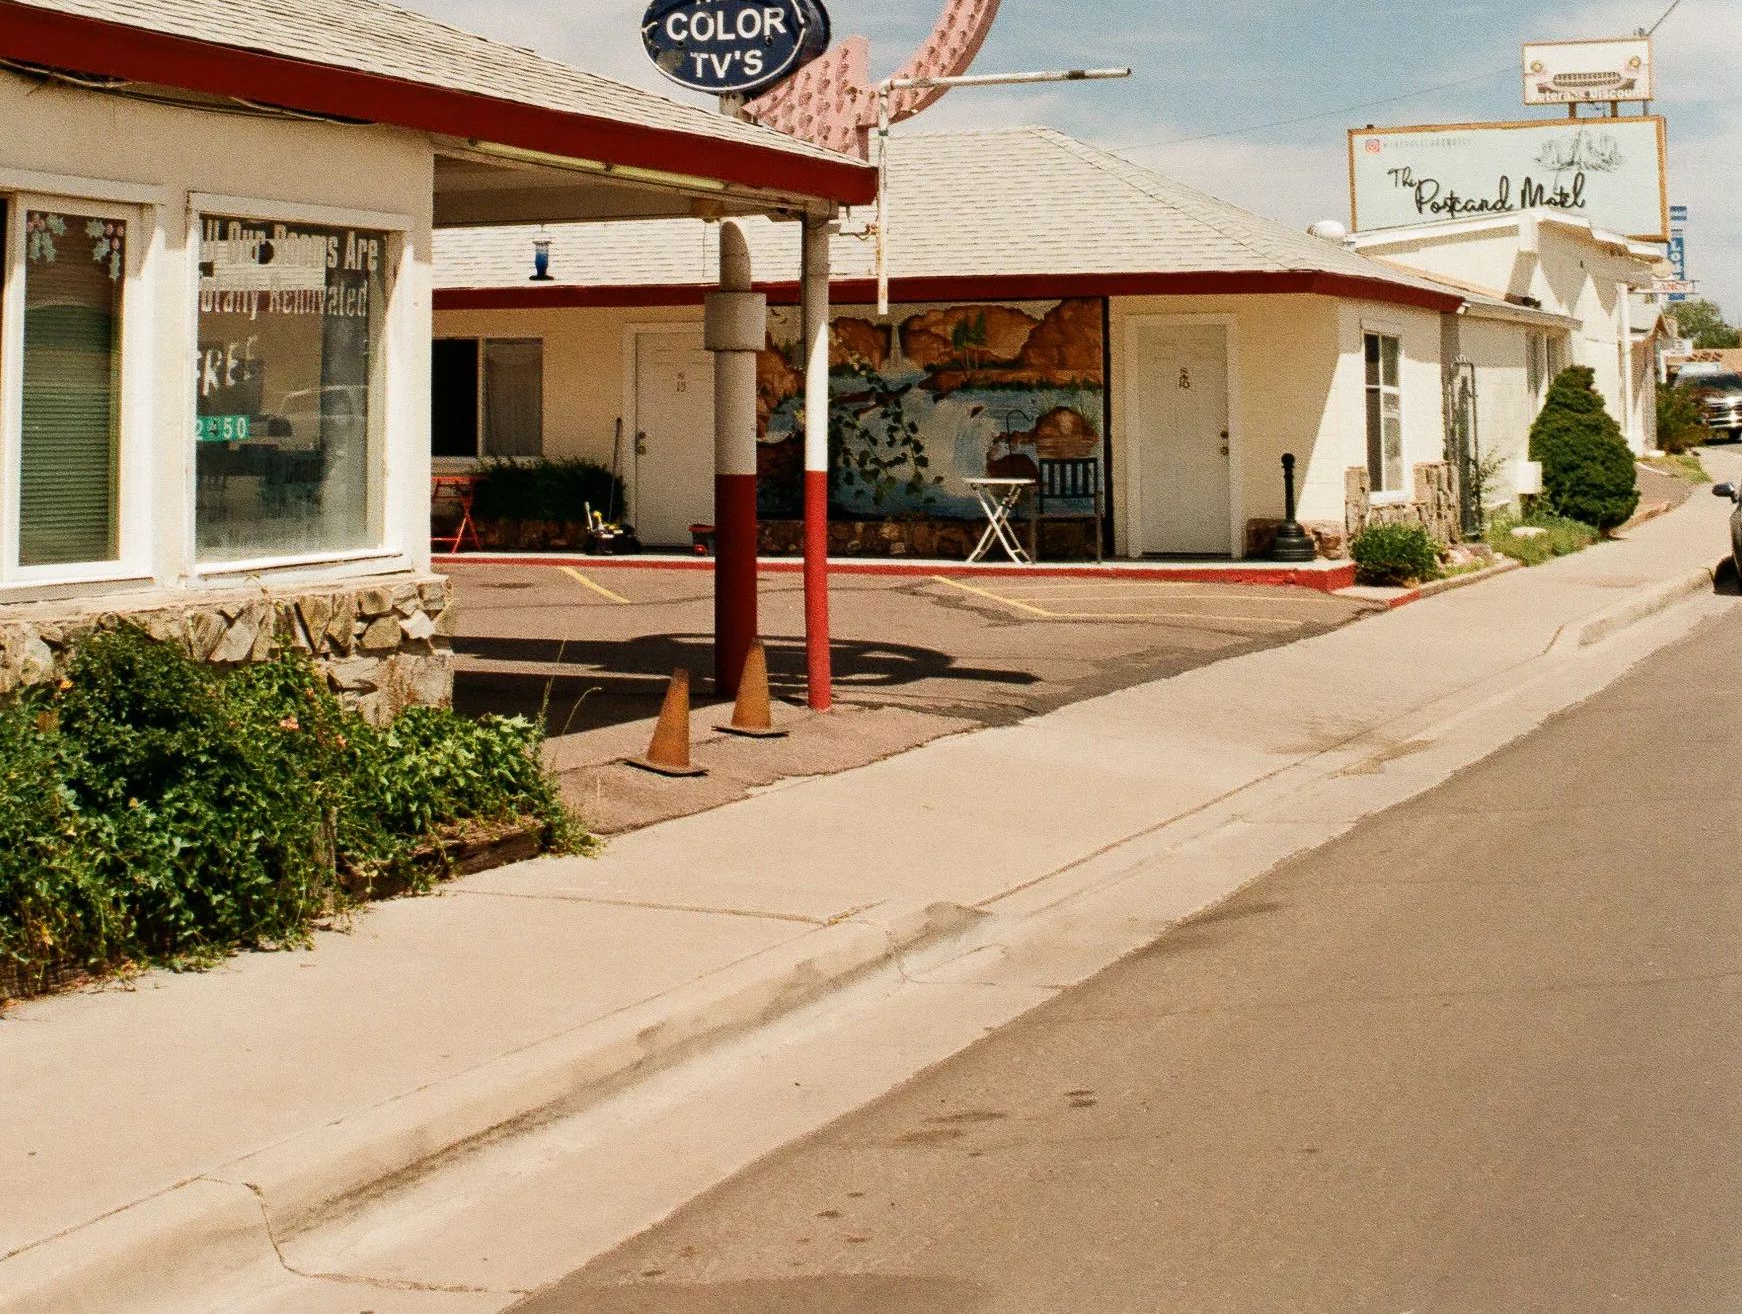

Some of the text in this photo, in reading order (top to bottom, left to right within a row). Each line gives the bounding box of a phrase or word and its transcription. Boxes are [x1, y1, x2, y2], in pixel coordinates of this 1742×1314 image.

[665, 7, 787, 42] COLOR
[689, 49, 763, 79] TV'S
[1387, 166, 1418, 188] The
[1415, 172, 1586, 219] Postcard Motel
[344, 231, 378, 271] Are
